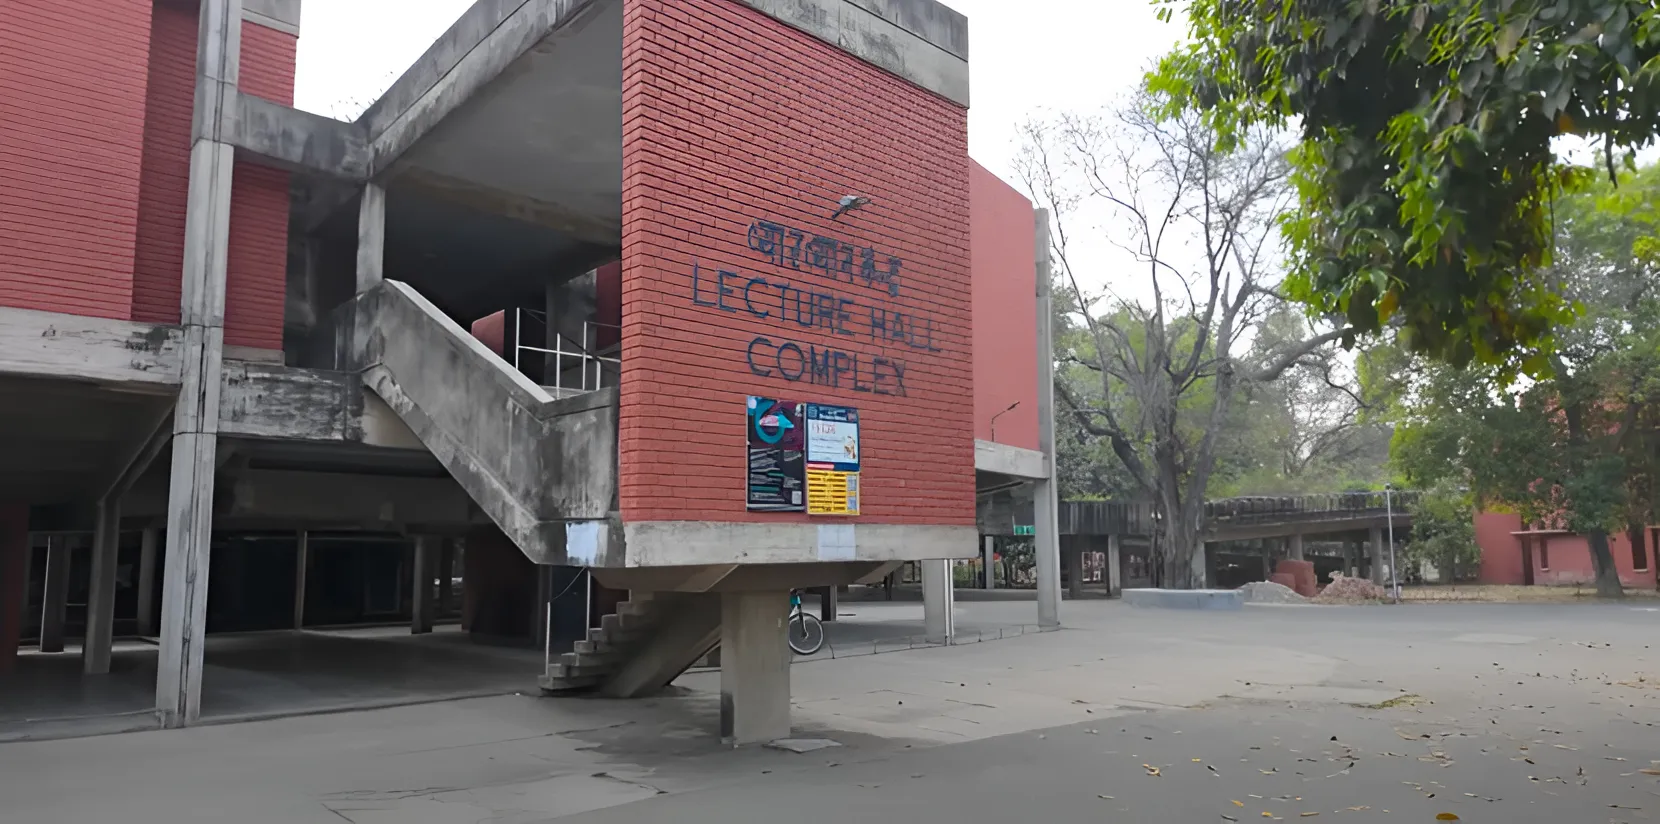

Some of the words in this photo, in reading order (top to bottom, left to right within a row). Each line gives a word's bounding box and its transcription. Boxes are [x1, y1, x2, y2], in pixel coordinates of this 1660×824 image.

[693, 263, 855, 336] LECTURE
[870, 308, 941, 352] HALL
[747, 337, 907, 397] COMPLEX
